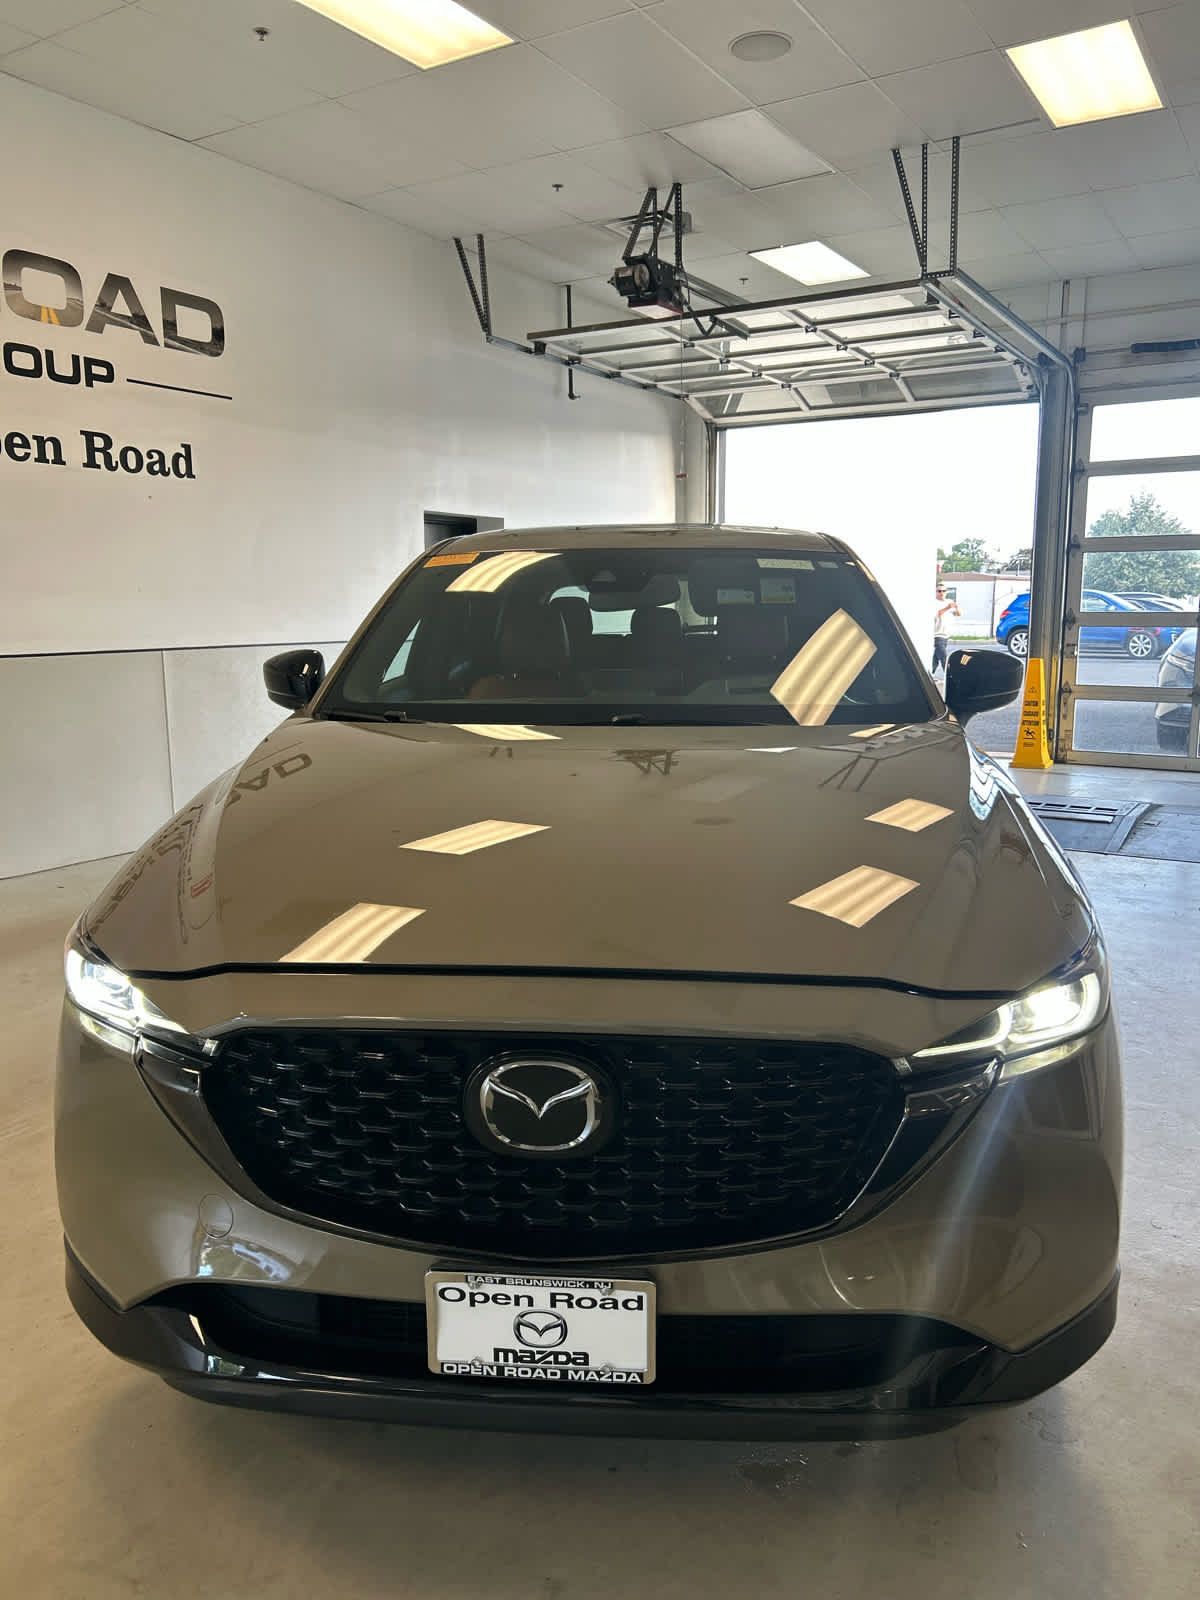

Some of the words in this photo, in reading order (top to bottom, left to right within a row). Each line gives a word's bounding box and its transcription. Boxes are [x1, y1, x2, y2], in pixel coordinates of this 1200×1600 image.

[0, 431, 67, 466] en
[80, 429, 196, 480] Road
[467, 1275, 501, 1285] EAST
[505, 1277, 590, 1289] BRUNSWICK,
[594, 1281, 612, 1289] NJ
[438, 1287, 534, 1308] Open
[550, 1292, 643, 1311] Road
[493, 1347, 590, 1366] mazda
[443, 1363, 497, 1376] OPEN
[504, 1366, 561, 1380] ROAD
[568, 1369, 642, 1384] MAZDA
